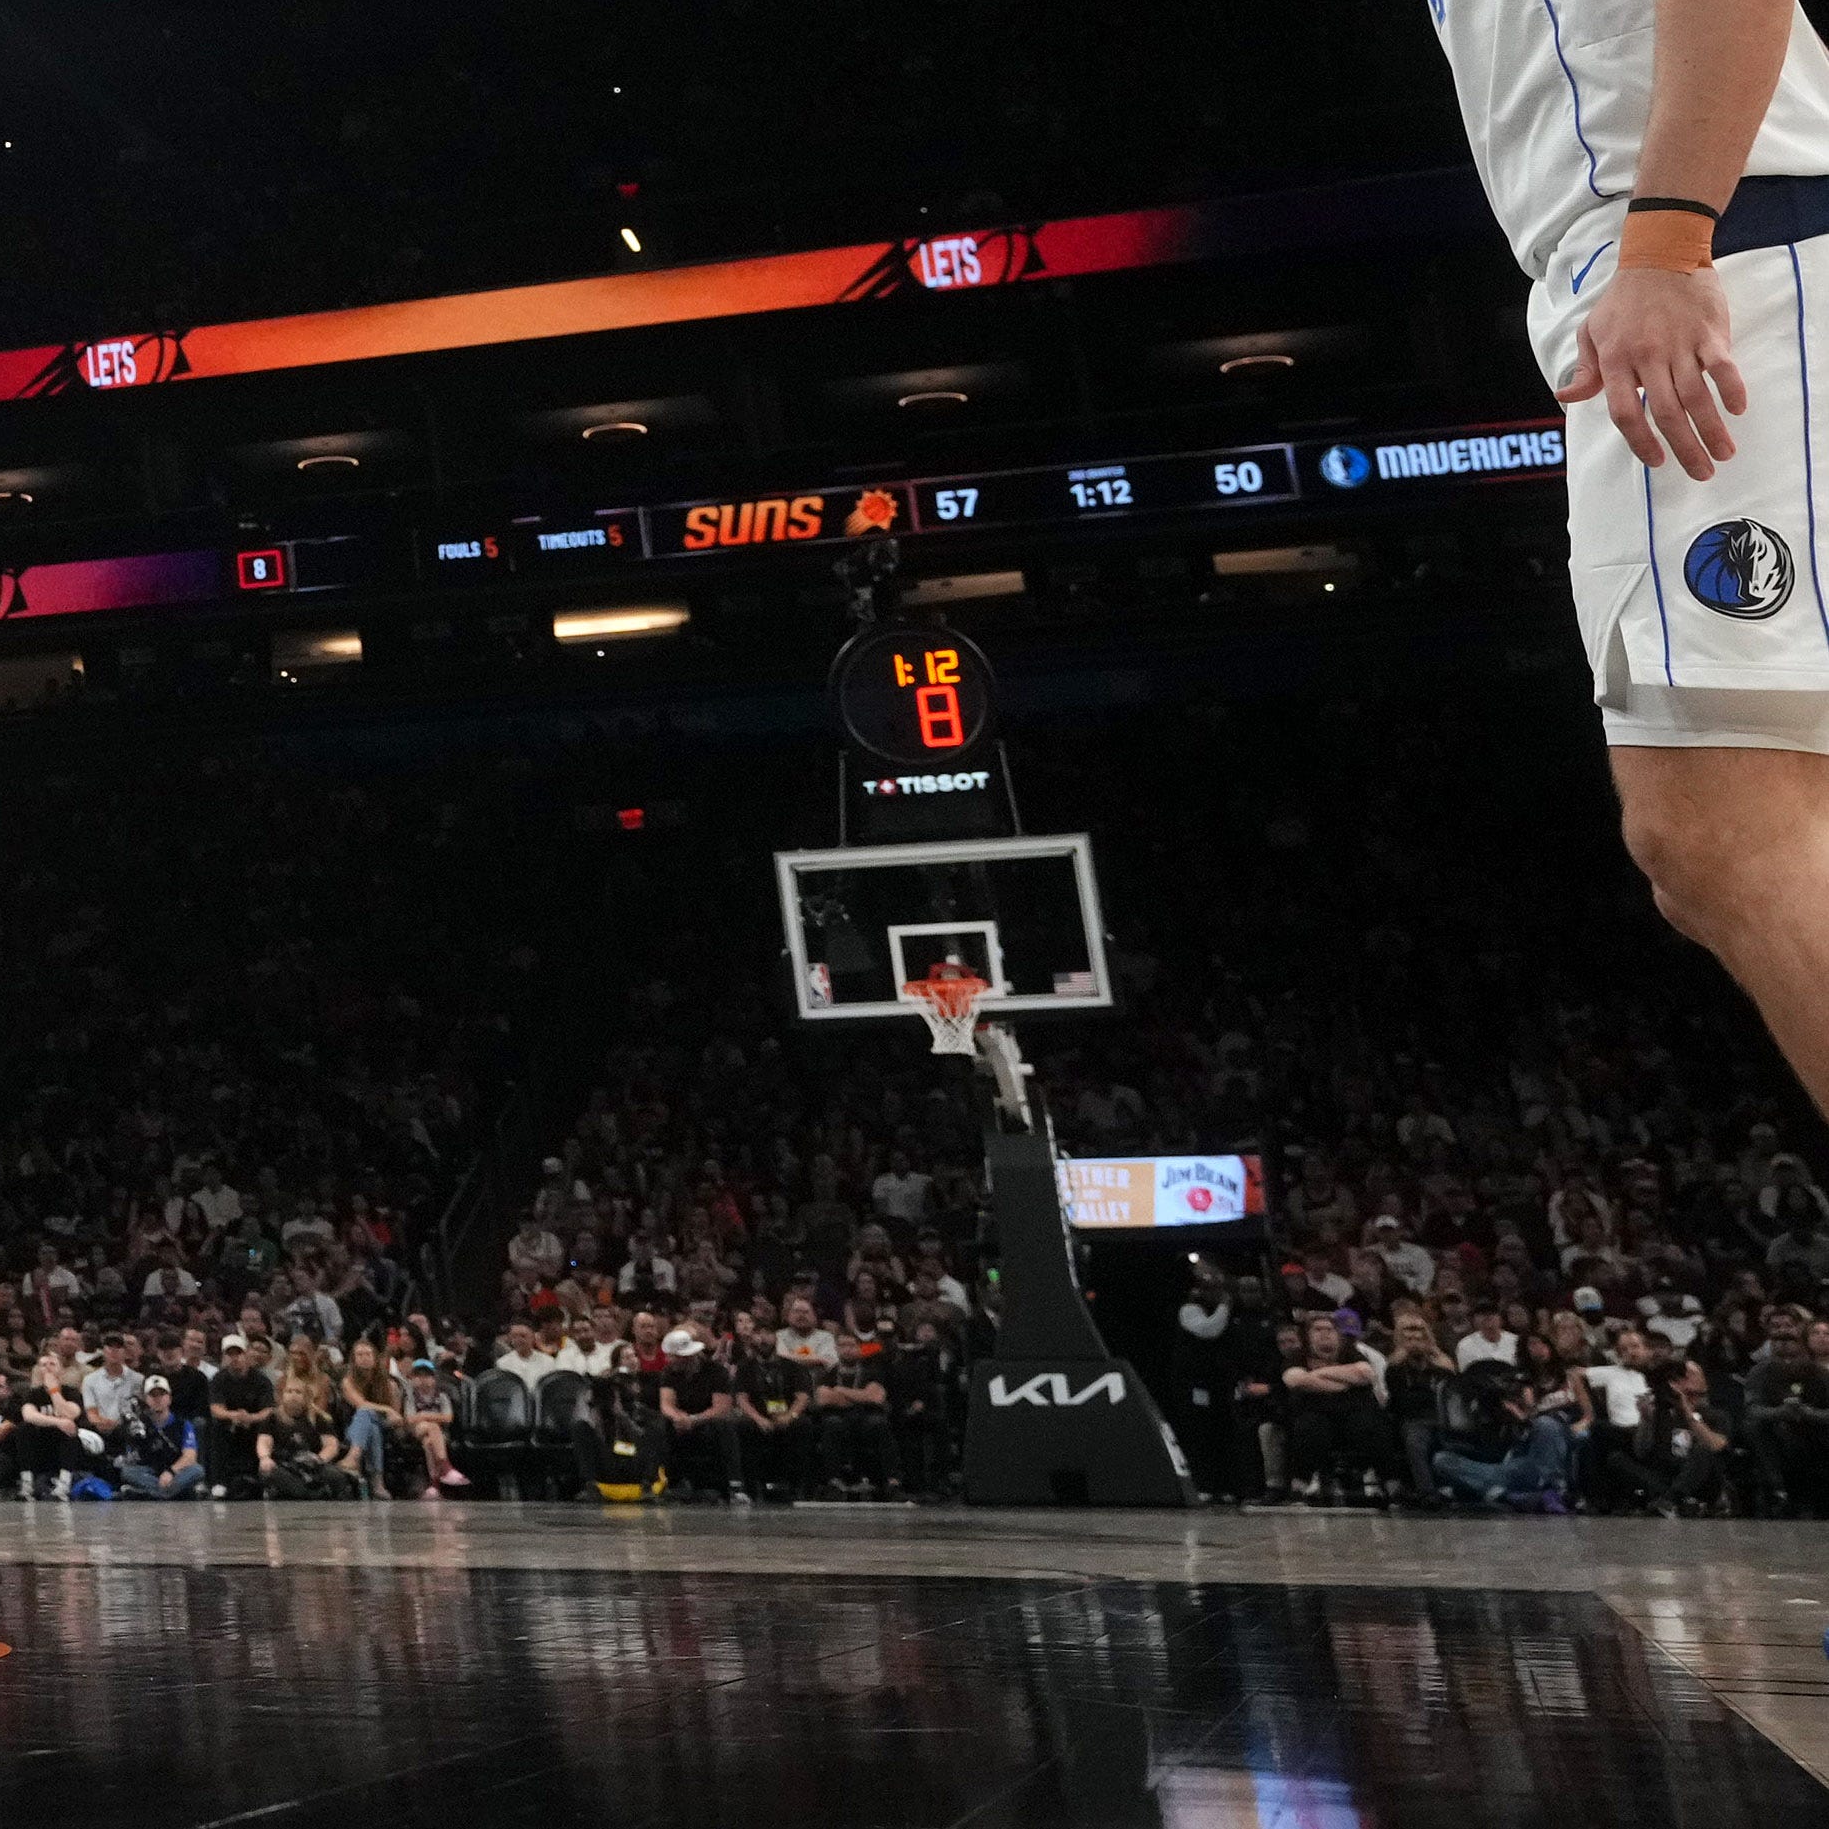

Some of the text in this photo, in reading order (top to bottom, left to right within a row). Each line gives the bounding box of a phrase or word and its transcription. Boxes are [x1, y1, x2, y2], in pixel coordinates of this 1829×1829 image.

[919, 237, 981, 288] LETS
[87, 341, 136, 387] LETS
[935, 488, 979, 520] 57
[1214, 462, 1263, 494] 50
[1070, 479, 1134, 508] 1:12
[438, 542, 481, 560] FOULS
[538, 529, 606, 550] TIMEOUTS
[253, 558, 267, 580] 8
[894, 649, 961, 688] 1:12
[916, 684, 964, 748] 8
[896, 772, 990, 795] TISSOT
[988, 1372, 1126, 1406] KIA
